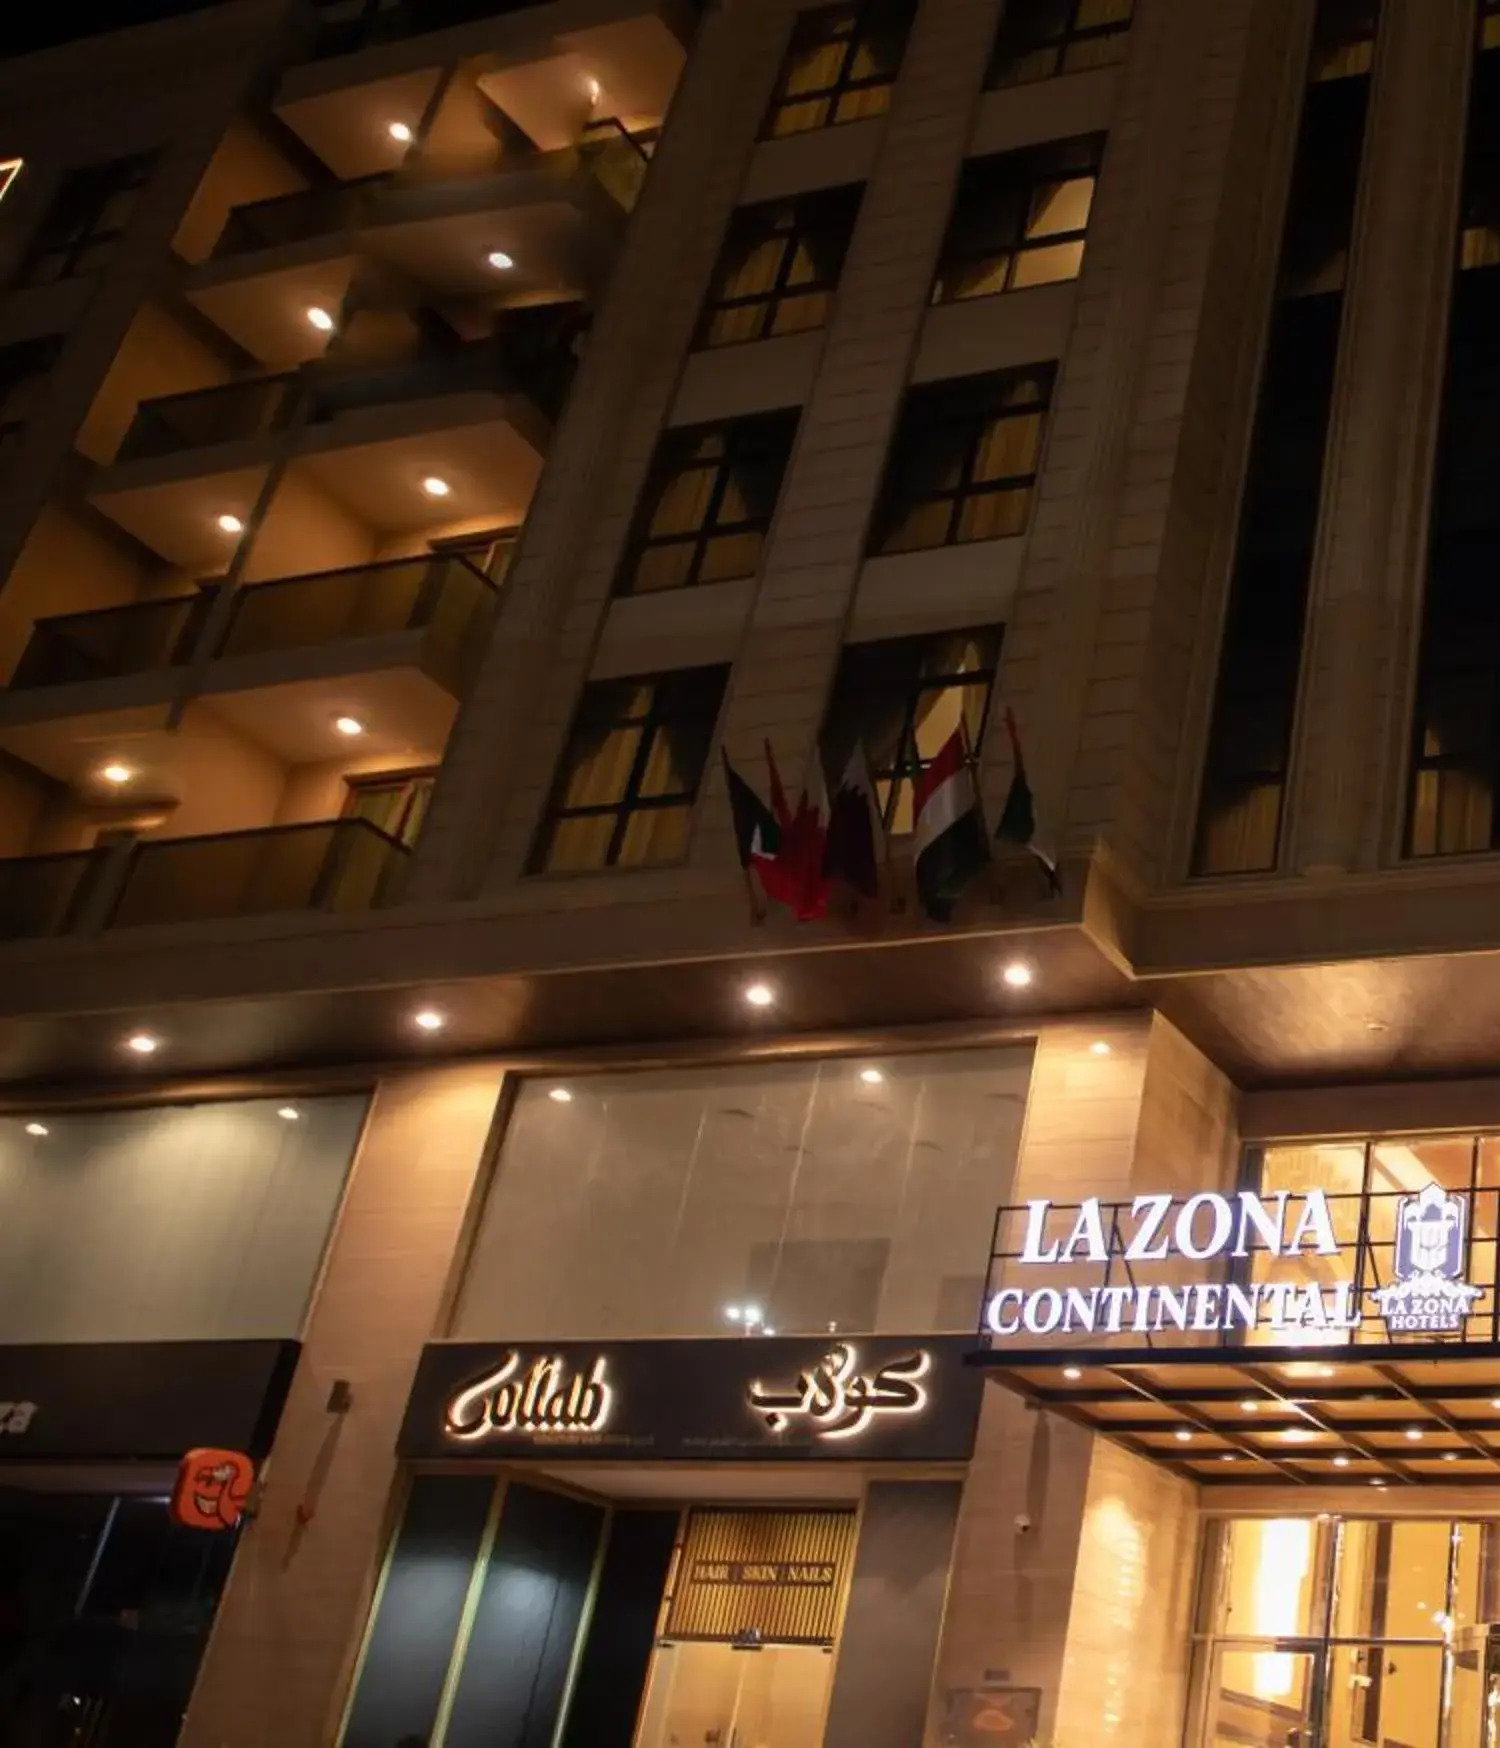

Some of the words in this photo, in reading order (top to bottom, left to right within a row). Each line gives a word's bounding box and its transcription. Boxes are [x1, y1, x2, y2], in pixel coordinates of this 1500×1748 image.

[1018, 1198, 1110, 1264] LA
[1125, 1187, 1341, 1260] ZONA
[986, 1281, 1361, 1334] CONTINENTAL
[1381, 1297, 1407, 1315] LA
[1410, 1295, 1470, 1315] ZONA
[1391, 1314, 1460, 1329] HOTELS
[742, 1564, 777, 1581] SKIN
[787, 1564, 834, 1582] NAILS
